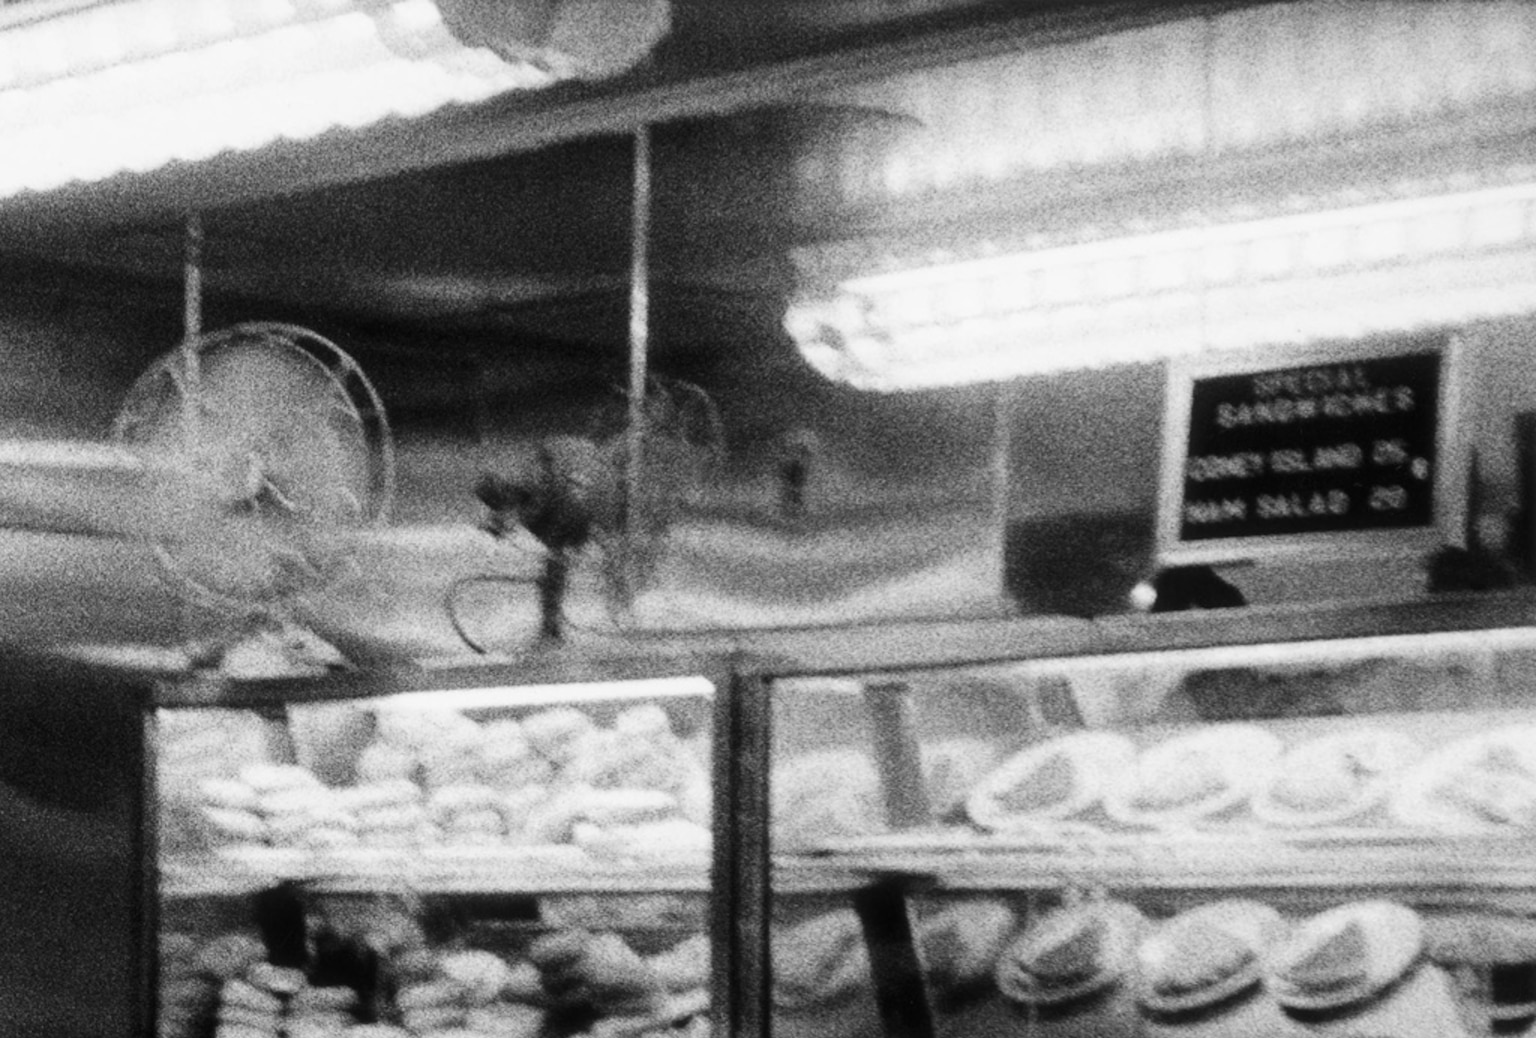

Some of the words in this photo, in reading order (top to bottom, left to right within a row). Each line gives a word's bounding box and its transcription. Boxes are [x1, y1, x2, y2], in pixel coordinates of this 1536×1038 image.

[1217, 385, 1414, 428] SANDWICHES
[1270, 444, 1362, 473] ISLAND
[1258, 490, 1350, 517] SALAD
